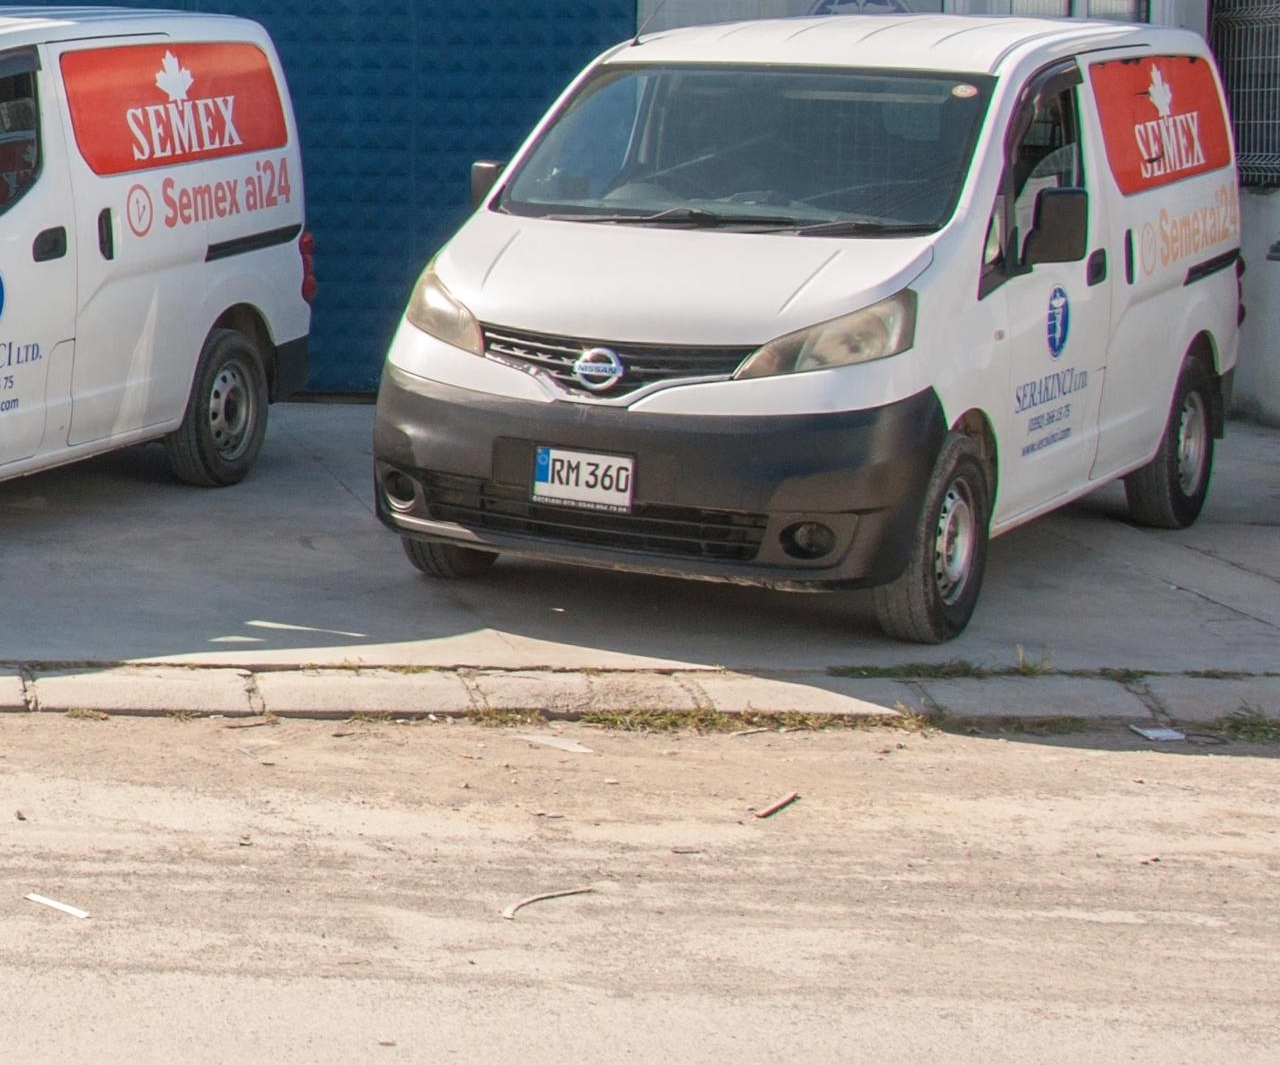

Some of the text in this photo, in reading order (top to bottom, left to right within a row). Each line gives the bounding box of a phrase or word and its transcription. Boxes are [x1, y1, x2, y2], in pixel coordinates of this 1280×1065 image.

[126, 95, 243, 161] SEMEX
[1134, 111, 1206, 179] SEMEX
[161, 157, 291, 228] Semex ai24
[16, 342, 43, 366] LTD.
[577, 364, 618, 375] NISSAN
[3, 375, 14, 390] 75
[550, 457, 630, 493] RM 360
